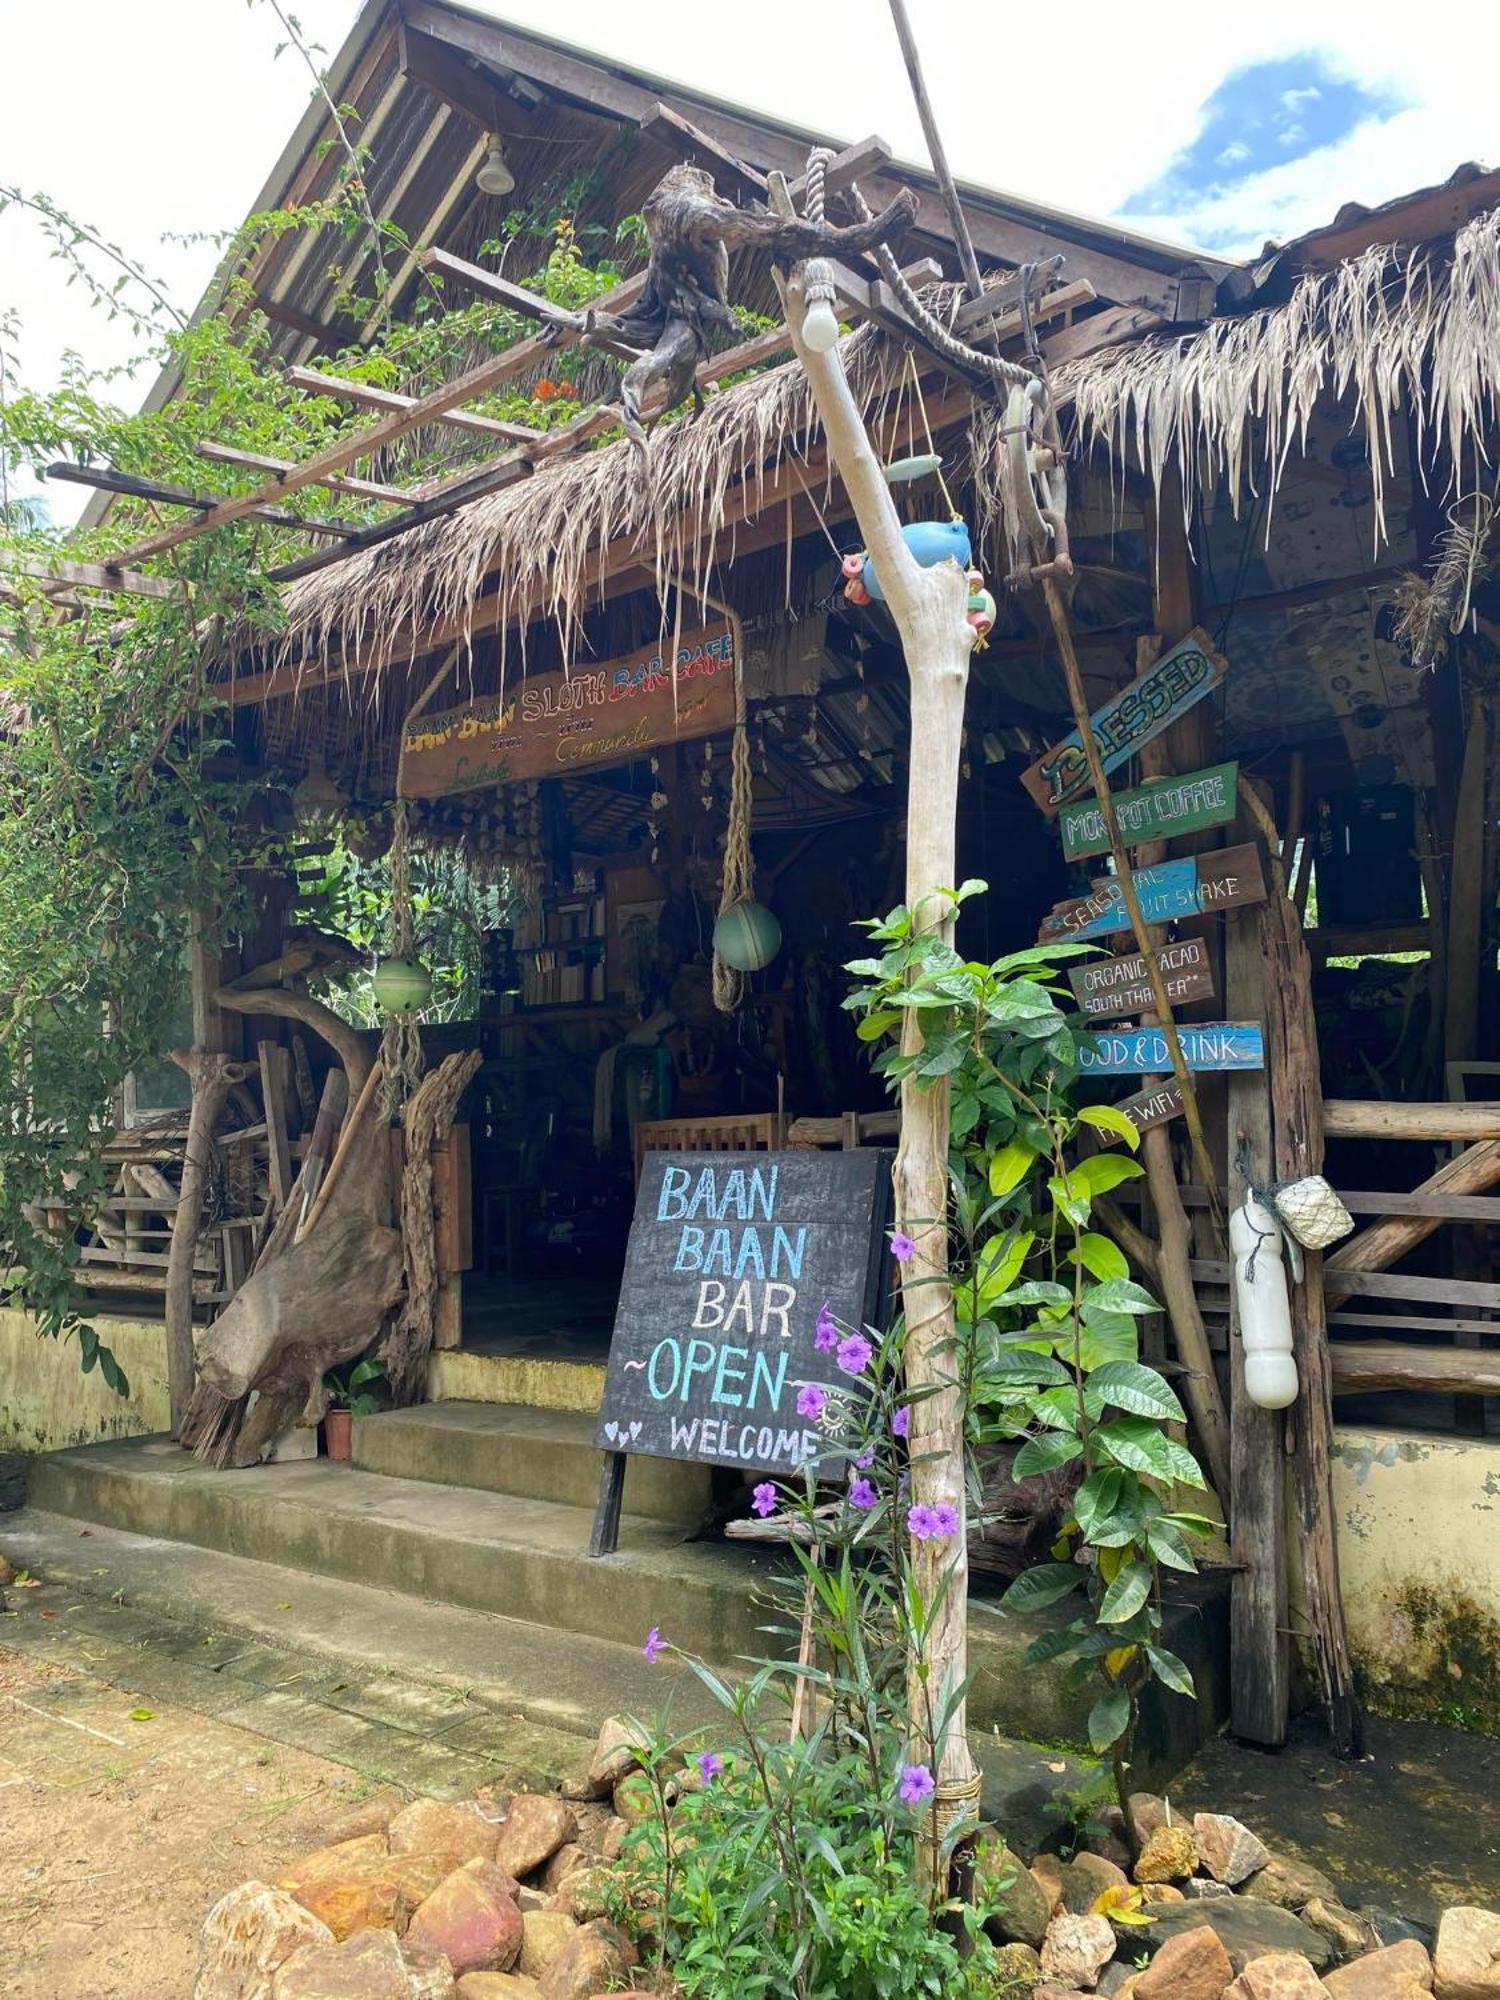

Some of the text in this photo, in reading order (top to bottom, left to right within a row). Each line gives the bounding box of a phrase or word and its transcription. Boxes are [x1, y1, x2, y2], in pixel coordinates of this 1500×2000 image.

[522, 672, 606, 722] SLOTH
[1066, 776, 1227, 846] MOK POT COFFEE
[1116, 878, 1241, 923] FUIT SHAKE
[1084, 944, 1201, 991] ORGANIC ACAO
[1084, 995, 1124, 1014] SOUTH
[1164, 978, 1188, 997] EA
[1079, 1037, 1129, 1067] OOD
[1154, 1033, 1239, 1064] DRINK
[1133, 1092, 1176, 1121] WIFI
[656, 1165, 778, 1222] BAAN
[673, 1224, 807, 1280] BAAN
[691, 1279, 797, 1338] BAR
[648, 1338, 790, 1412] OPEN
[670, 1416, 822, 1468] WELCOME
